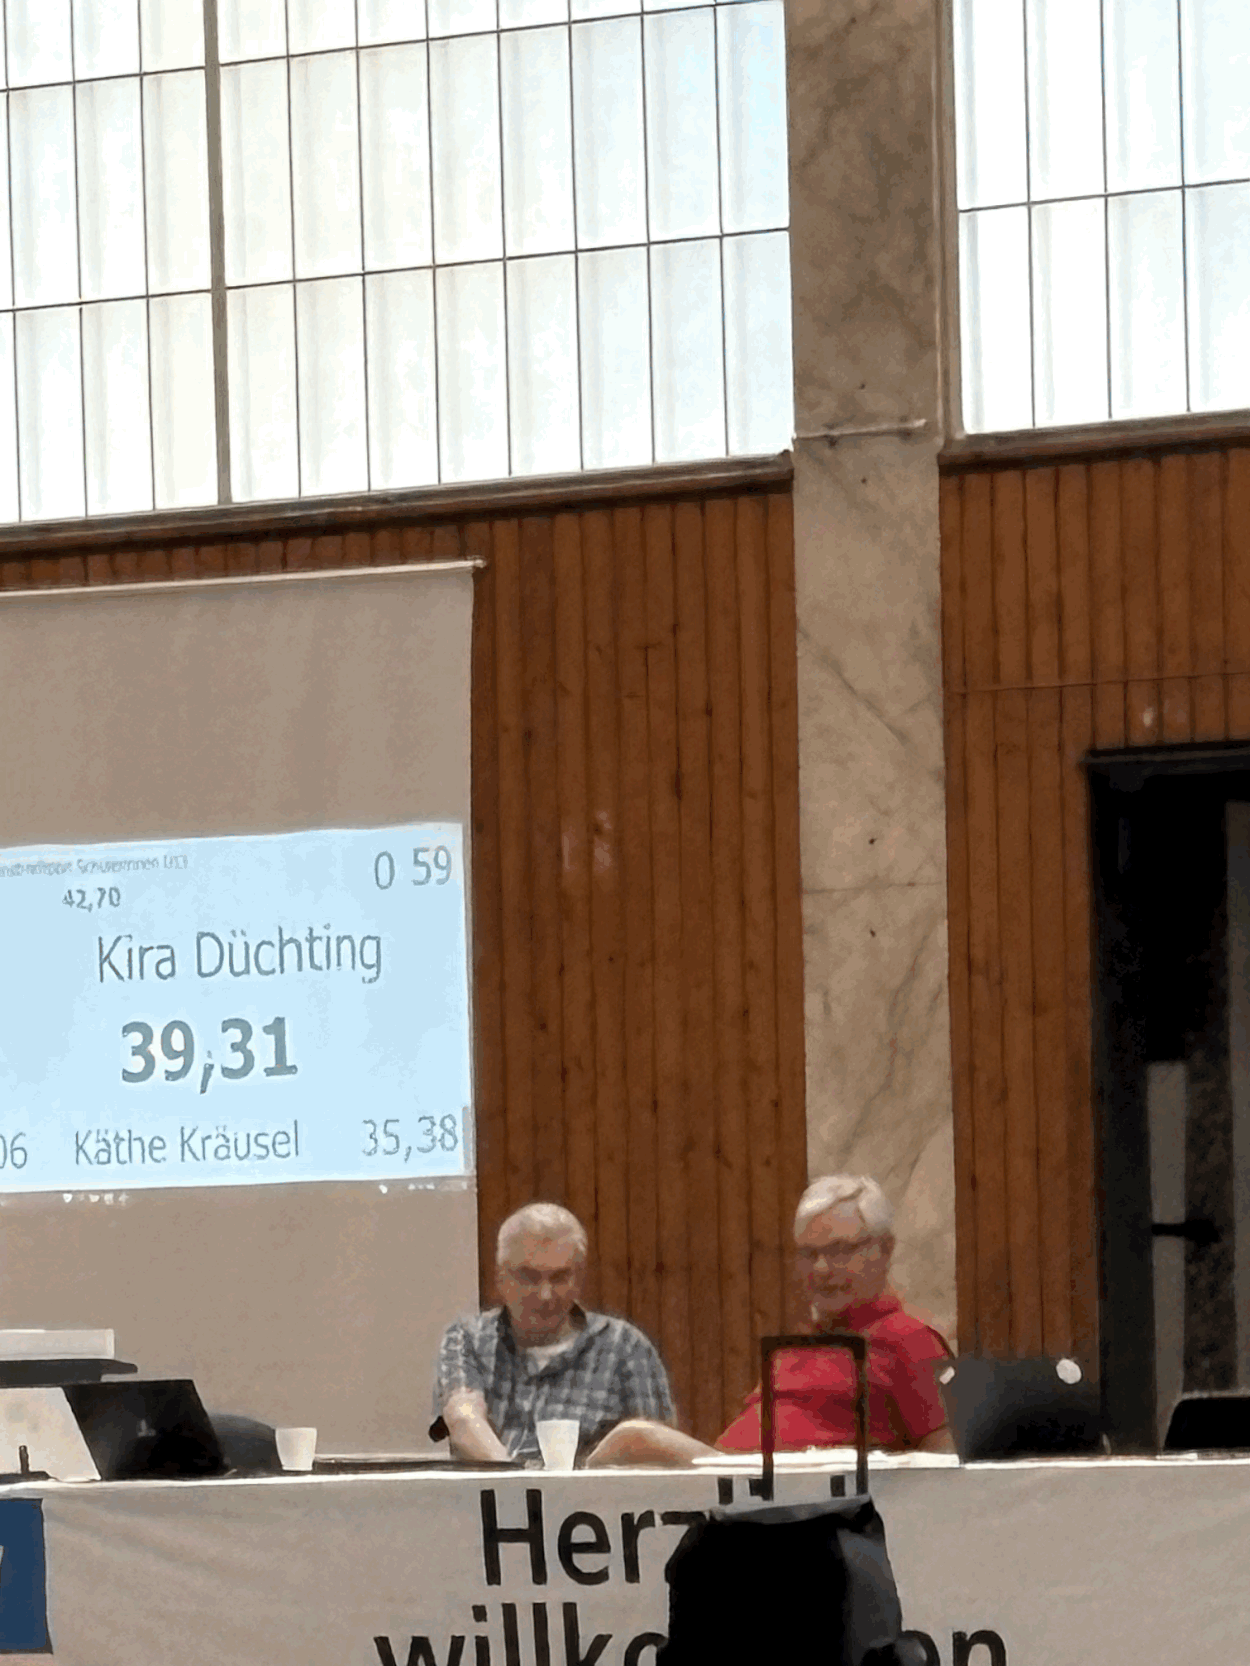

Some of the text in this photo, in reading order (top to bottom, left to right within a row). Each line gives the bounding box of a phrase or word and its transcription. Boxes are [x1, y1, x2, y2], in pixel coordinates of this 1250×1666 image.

[410, 845, 452, 886] 59
[62, 886, 121, 913] 42,70
[97, 923, 383, 984] Kira Düchting
[120, 1015, 298, 1095] 39,31
[74, 1128, 167, 1165] Käthe
[179, 1118, 300, 1162] Kräusel
[361, 1113, 458, 1163] 35,38
